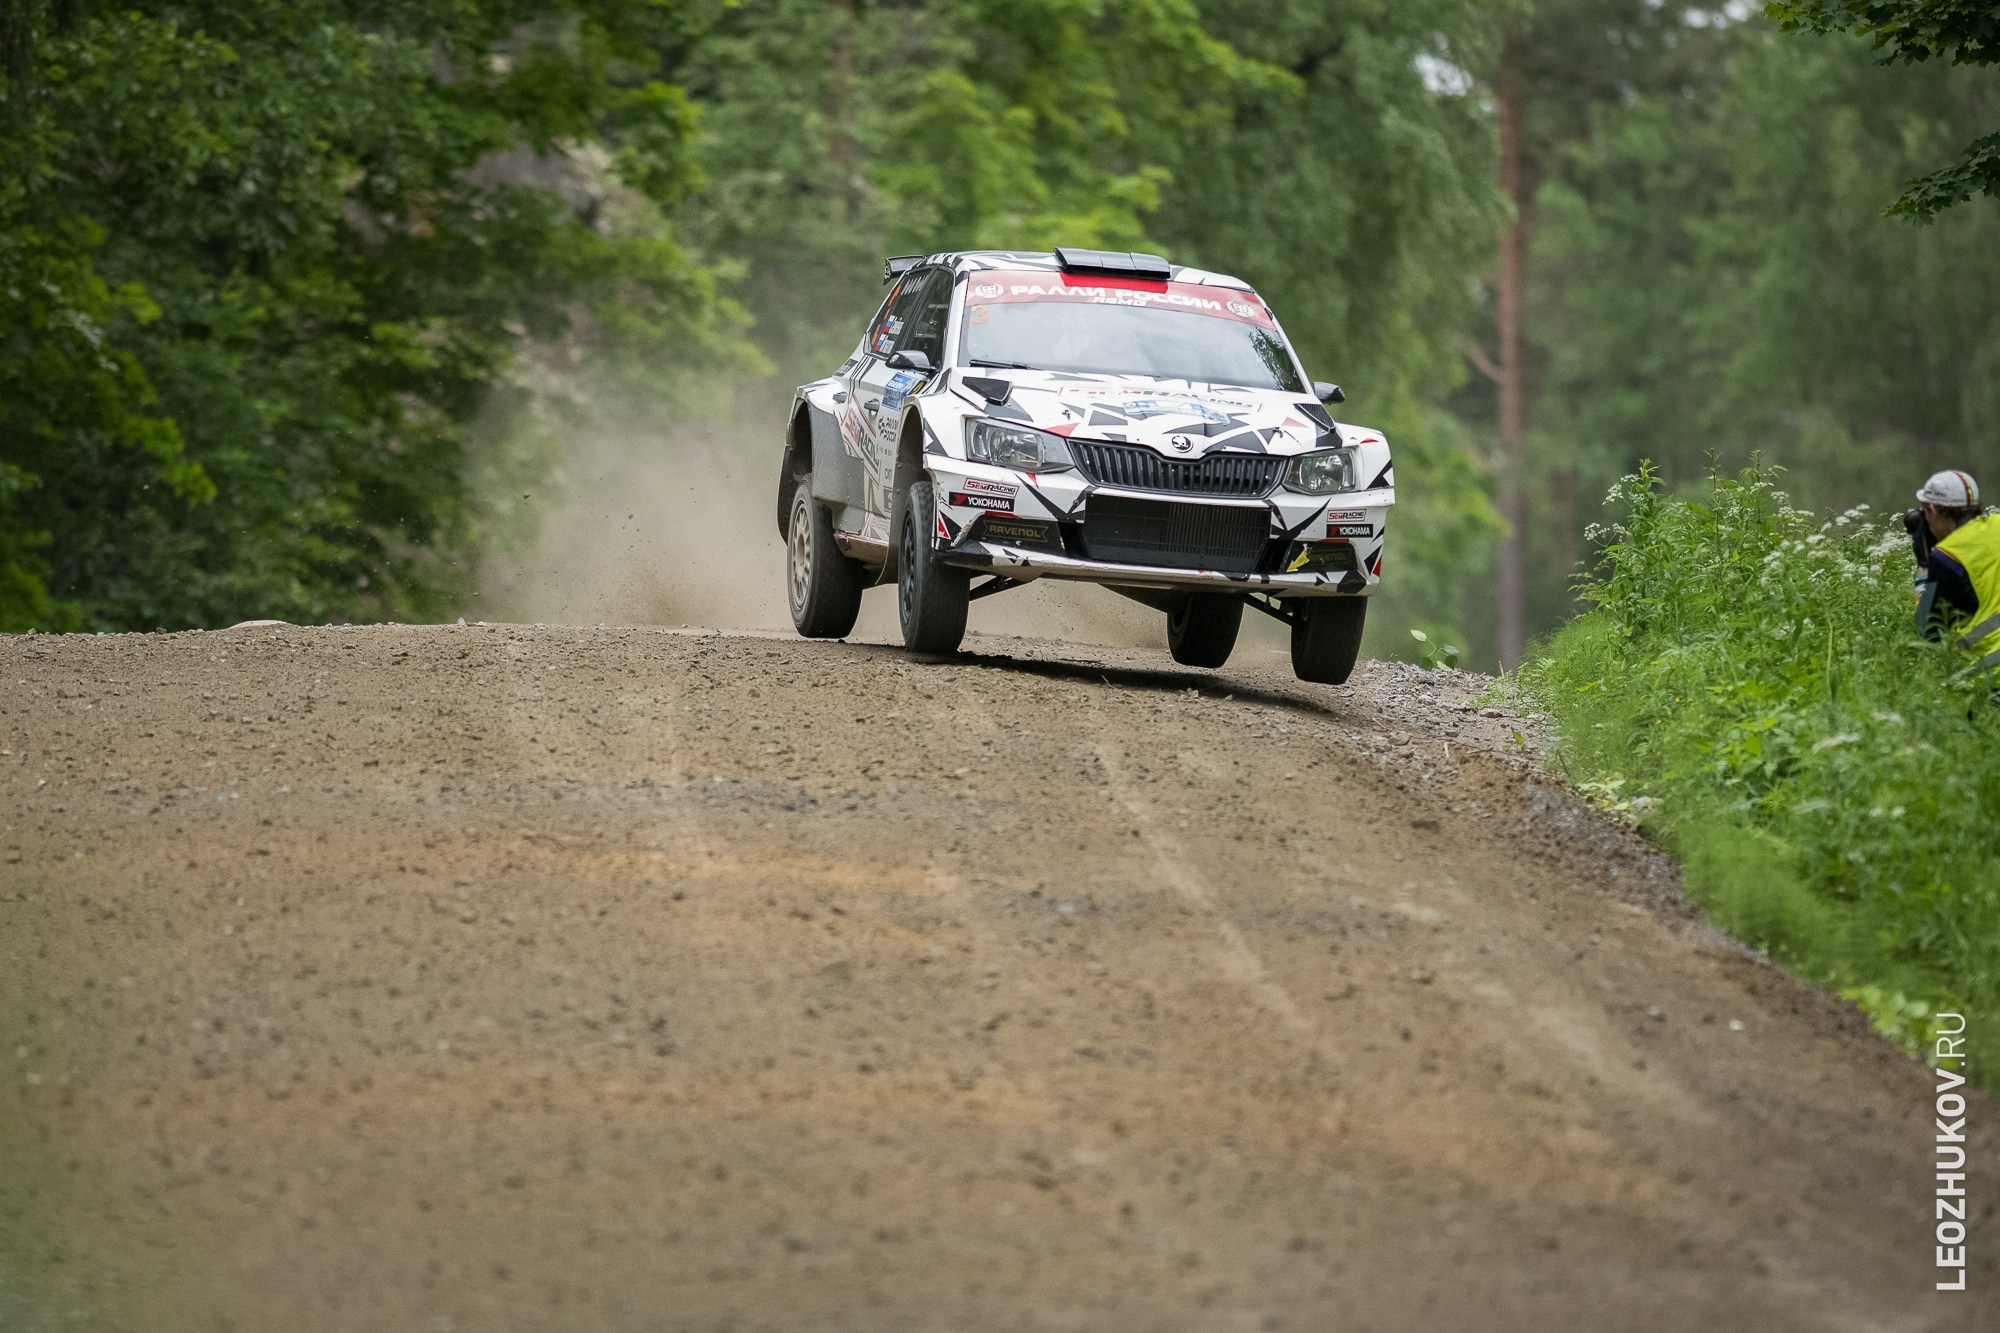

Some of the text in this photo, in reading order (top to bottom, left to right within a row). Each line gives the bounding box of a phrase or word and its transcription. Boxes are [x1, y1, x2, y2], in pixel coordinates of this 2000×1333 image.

[1010, 284, 1222, 311] РАЛЛИ РОССИИ
[969, 304, 989, 325] 3
[967, 496, 1011, 510] YOKOHAMA
[988, 525, 1041, 538] RAVENOL
[1338, 526, 1371, 536] YOKOHAMA
